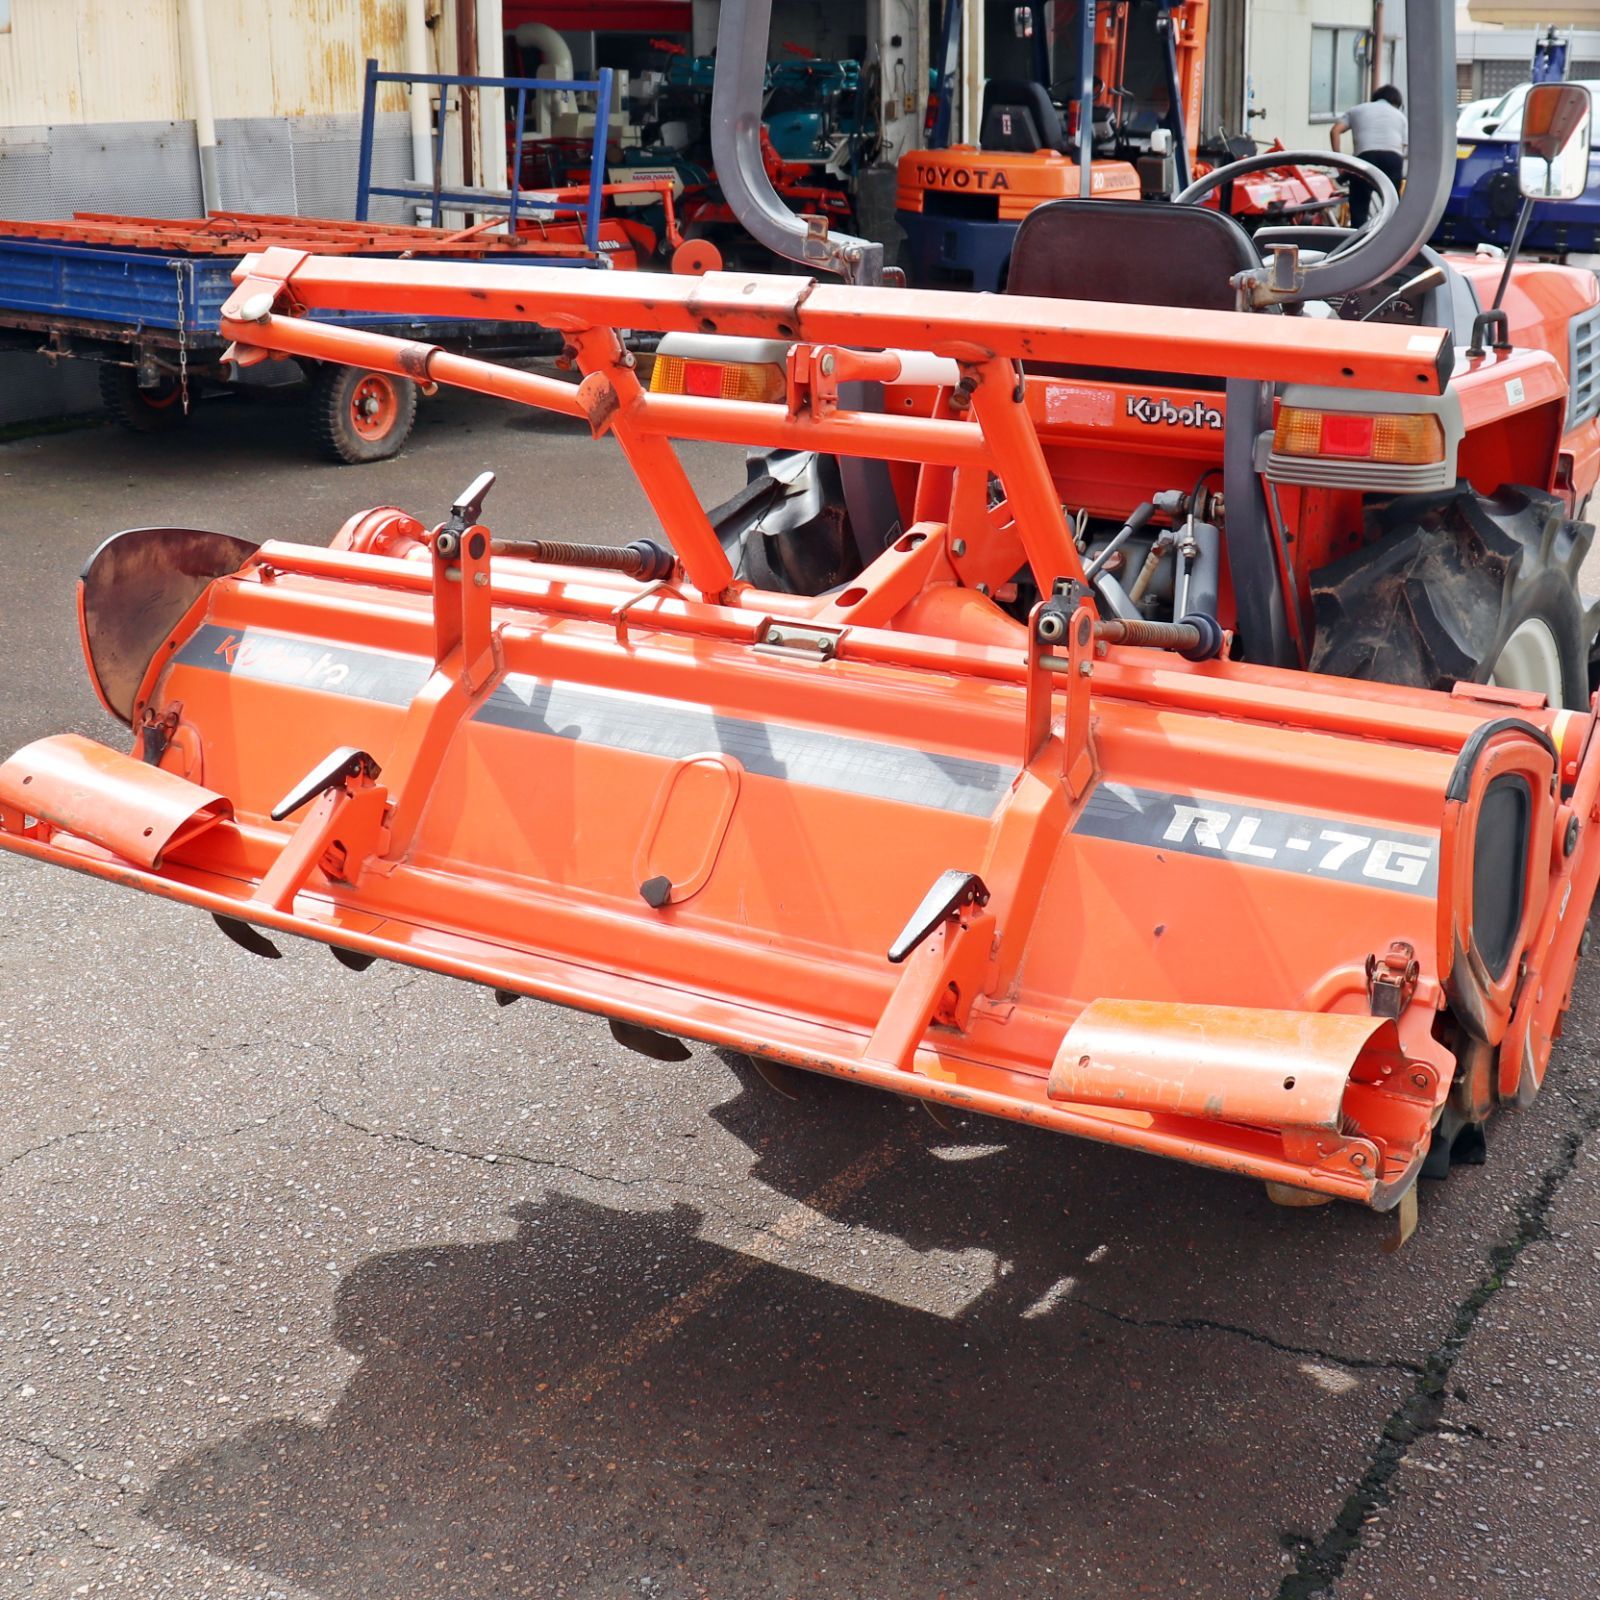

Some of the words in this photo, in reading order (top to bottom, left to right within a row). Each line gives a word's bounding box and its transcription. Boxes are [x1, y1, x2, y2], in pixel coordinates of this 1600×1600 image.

[916, 165, 1009, 190] TOYOTA
[1093, 172, 1104, 190] 20
[1126, 395, 1224, 429] Kubota
[1162, 804, 1432, 886] RL-7G
